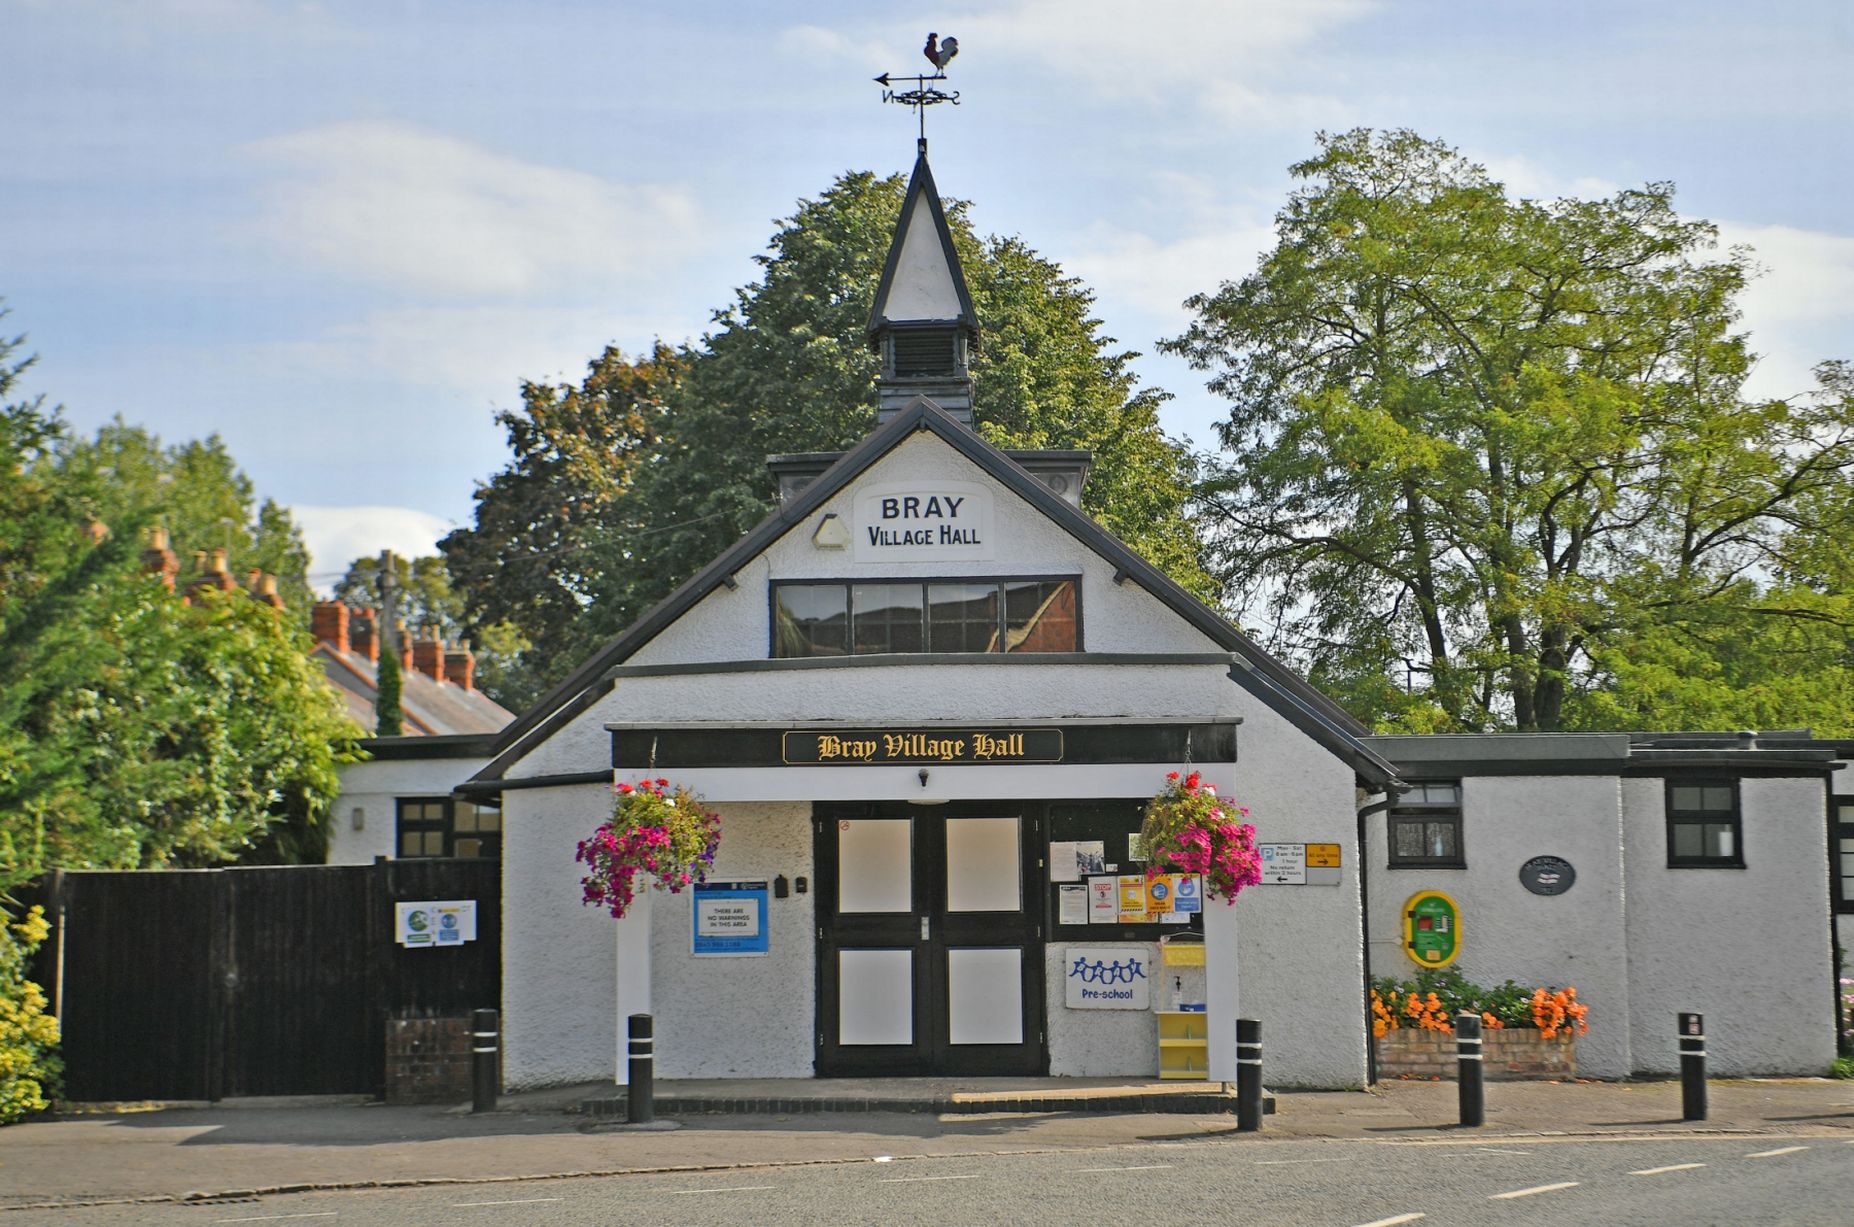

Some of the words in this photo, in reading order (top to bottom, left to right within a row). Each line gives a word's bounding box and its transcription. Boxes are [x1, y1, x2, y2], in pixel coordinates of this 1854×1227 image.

[882, 496, 964, 519] BRAY
[868, 526, 934, 546] VILLAGE
[940, 525, 981, 544] HALL
[817, 735, 877, 762] Bray
[883, 733, 965, 761] Village
[972, 733, 1024, 760] Hall
[1263, 849, 1272, 860] P
[1082, 988, 1133, 999] Pre-school
